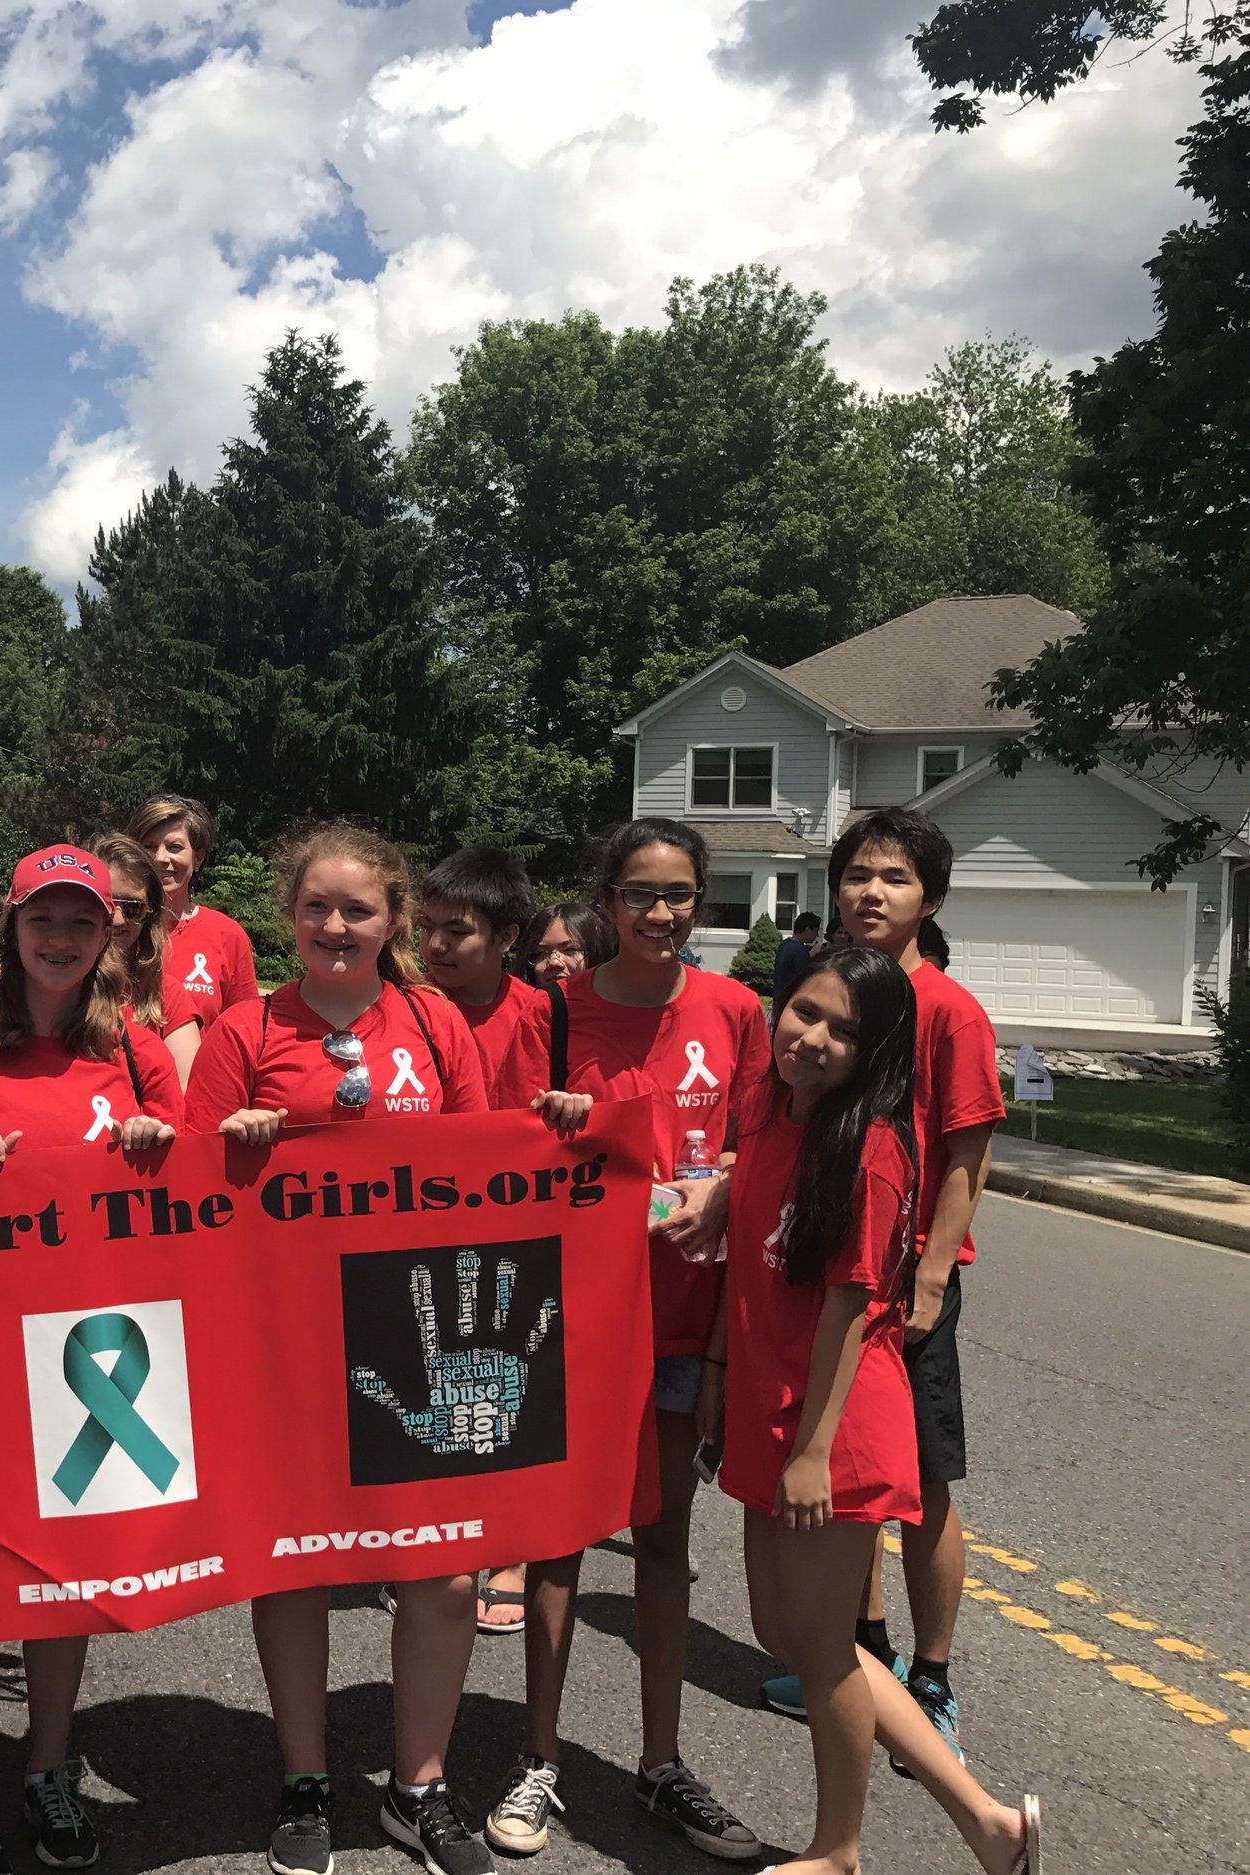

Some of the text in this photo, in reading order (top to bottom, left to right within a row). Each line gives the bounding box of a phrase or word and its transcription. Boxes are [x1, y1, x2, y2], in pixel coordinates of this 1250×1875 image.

[36, 854, 96, 880] USA
[183, 981, 215, 996] WSTG
[384, 1096, 430, 1112] WSTG
[675, 1092, 720, 1108] WSTG
[91, 1187, 235, 1241] The
[261, 1152, 609, 1222] Girls.org
[456, 1256, 481, 1270] stop
[762, 1248, 787, 1272] WST
[410, 1269, 419, 1292] abuse
[457, 1270, 480, 1279] stop
[413, 1292, 422, 1307] stop
[418, 1274, 432, 1305] sexual
[496, 1275, 509, 1310] sexual
[458, 1283, 474, 1334] abuse
[493, 1309, 501, 1330] abuse
[538, 1308, 547, 1333] abuse
[420, 1305, 437, 1357] sexual
[528, 1330, 538, 1351] stop
[429, 1348, 472, 1369] sexual
[473, 1347, 482, 1365] stop
[356, 1370, 376, 1379] stop
[442, 1355, 500, 1382] sexual
[355, 1379, 387, 1391] stop
[430, 1382, 500, 1406] abuse
[500, 1354, 521, 1411] abuse
[402, 1411, 434, 1427] stop
[413, 1426, 431, 1434] stop
[432, 1406, 452, 1437] stop
[450, 1404, 472, 1442] stop
[470, 1402, 498, 1454] stop
[498, 1412, 509, 1441] sexual
[432, 1441, 474, 1454] abuse
[270, 1519, 484, 1557] ADVOCATE
[18, 1555, 224, 1605] EMPOWER
